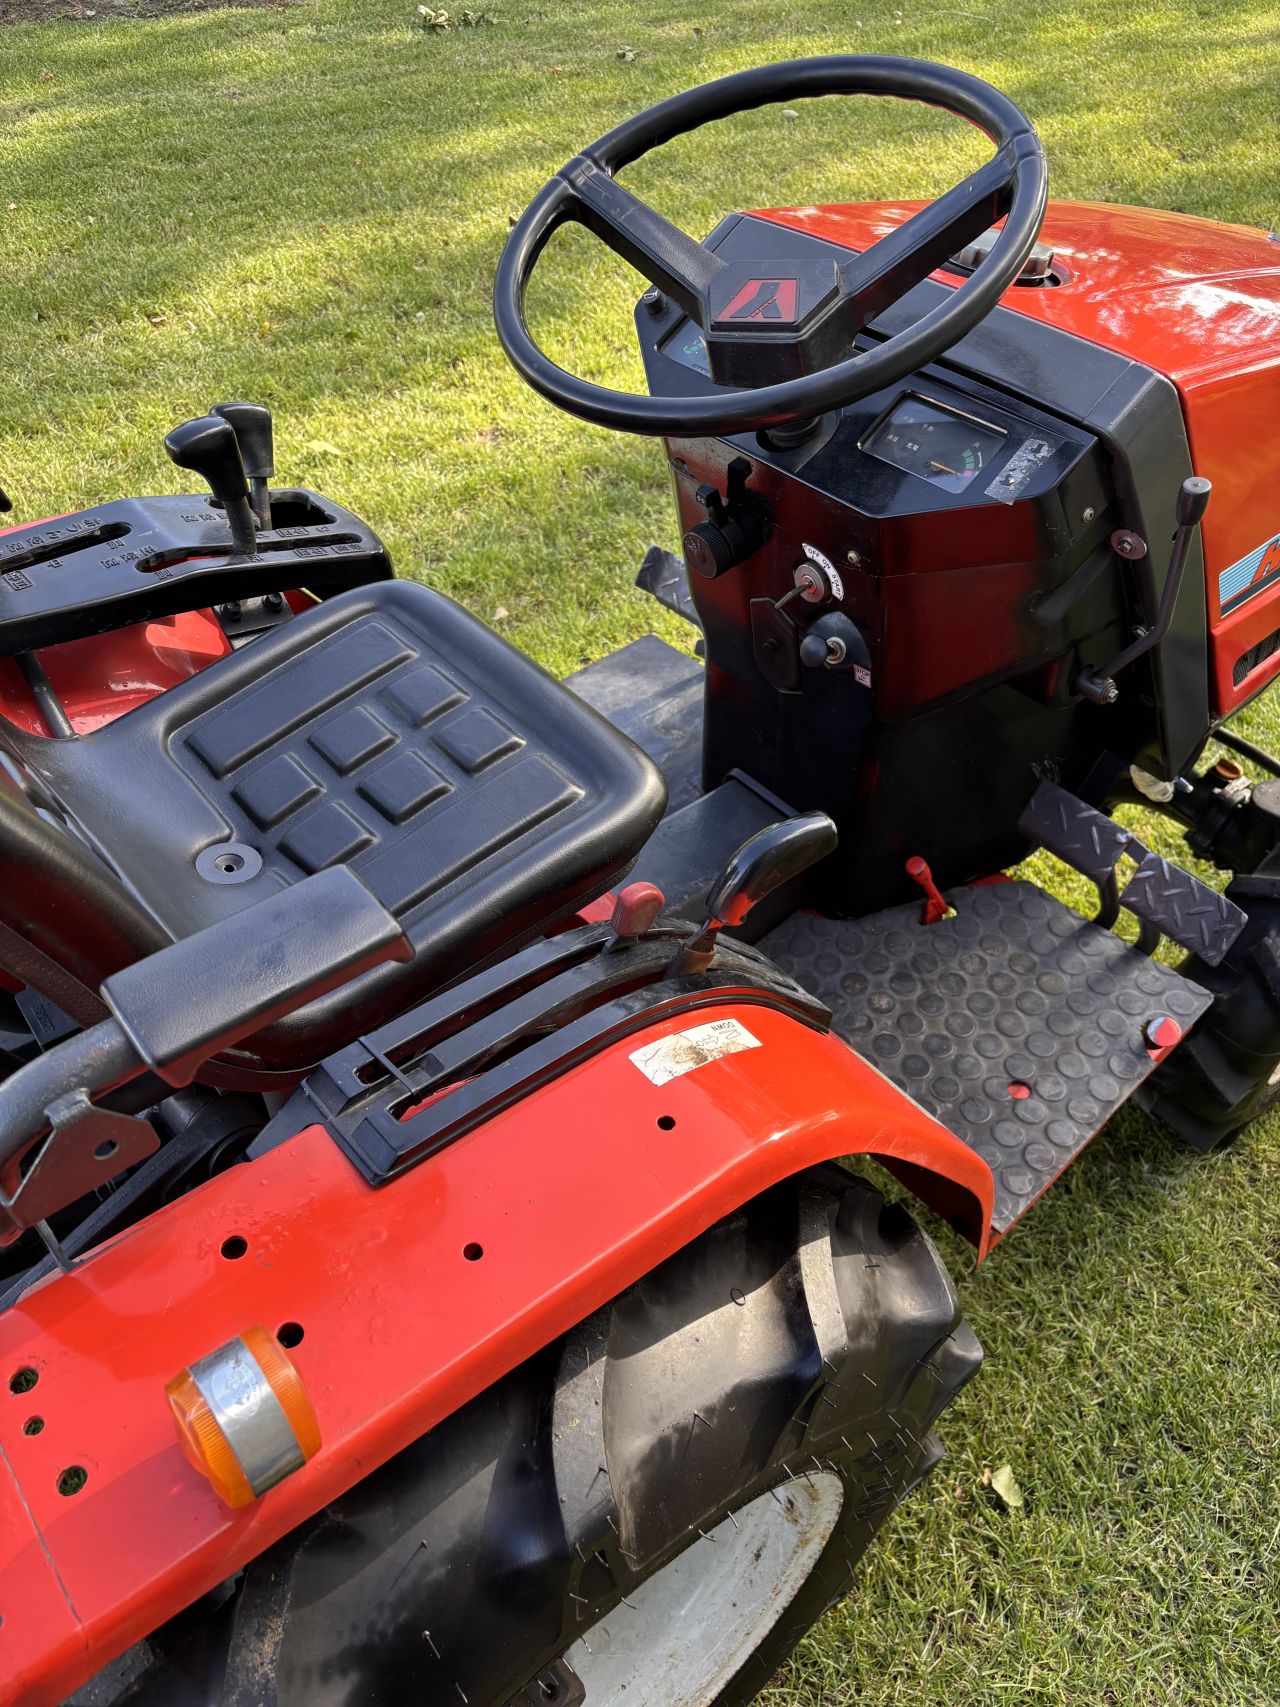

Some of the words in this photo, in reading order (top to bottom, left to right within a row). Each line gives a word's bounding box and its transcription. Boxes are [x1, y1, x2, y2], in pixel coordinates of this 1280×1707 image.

[808, 548, 820, 558] OFF
[822, 559, 831, 569] ON
[832, 574, 841, 596] START
[856, 667, 870, 677] STOP
[711, 1021, 735, 1032] DOWN
